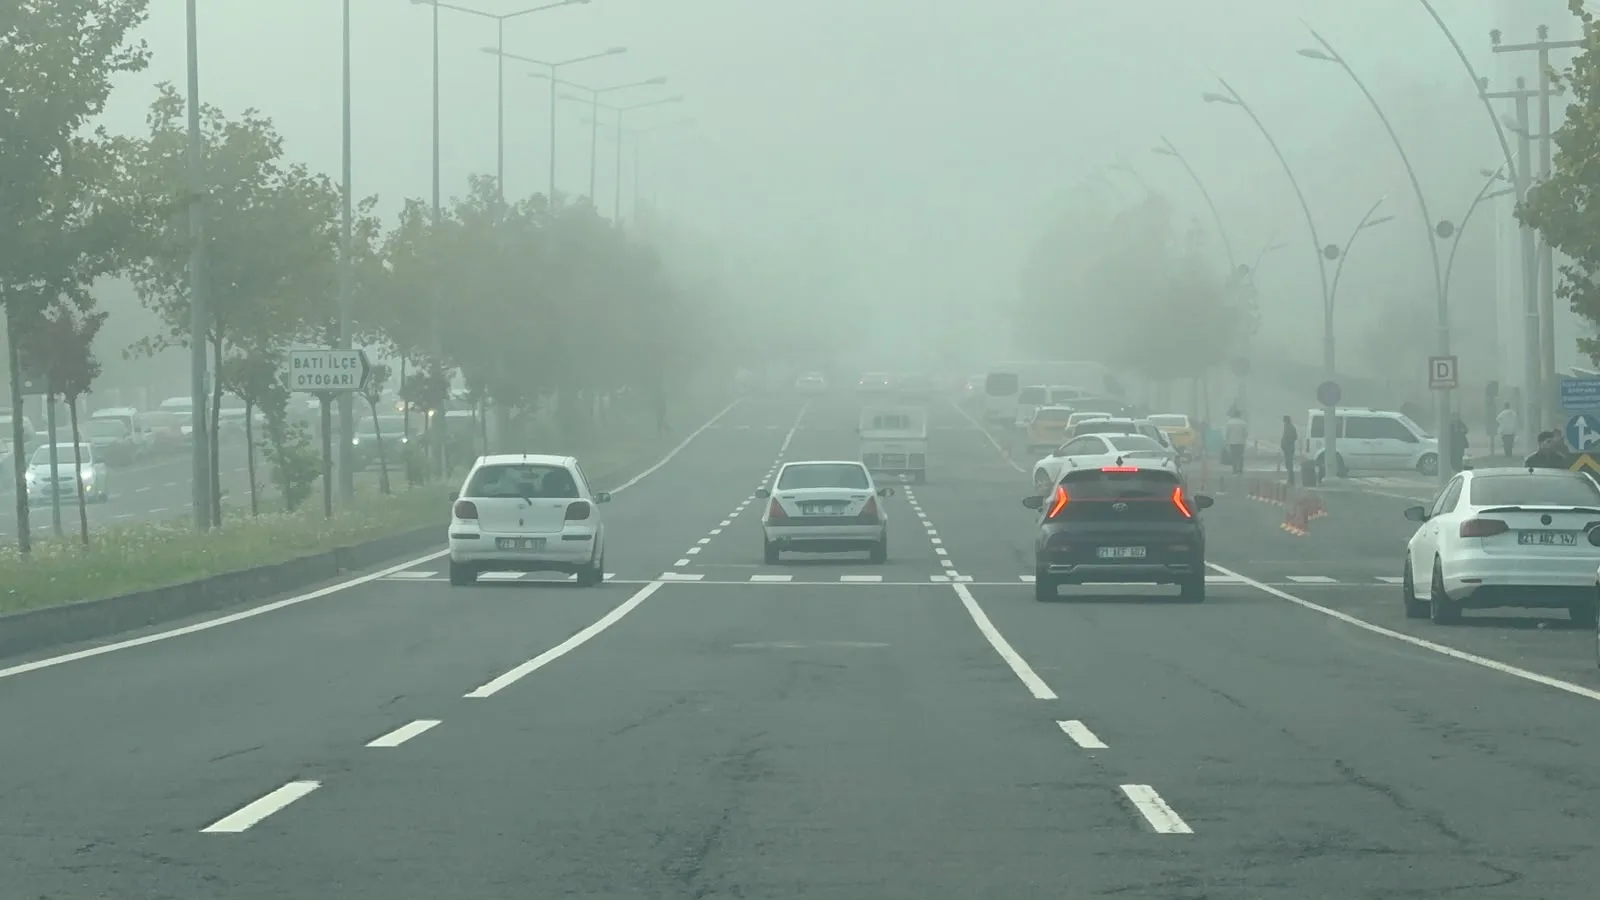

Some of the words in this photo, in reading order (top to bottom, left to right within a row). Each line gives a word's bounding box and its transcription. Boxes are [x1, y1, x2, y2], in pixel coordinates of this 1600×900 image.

[294, 357, 323, 369] BATI
[328, 353, 357, 370] İLÇE
[1437, 362, 1449, 378] D
[297, 374, 354, 385] OTOGARI
